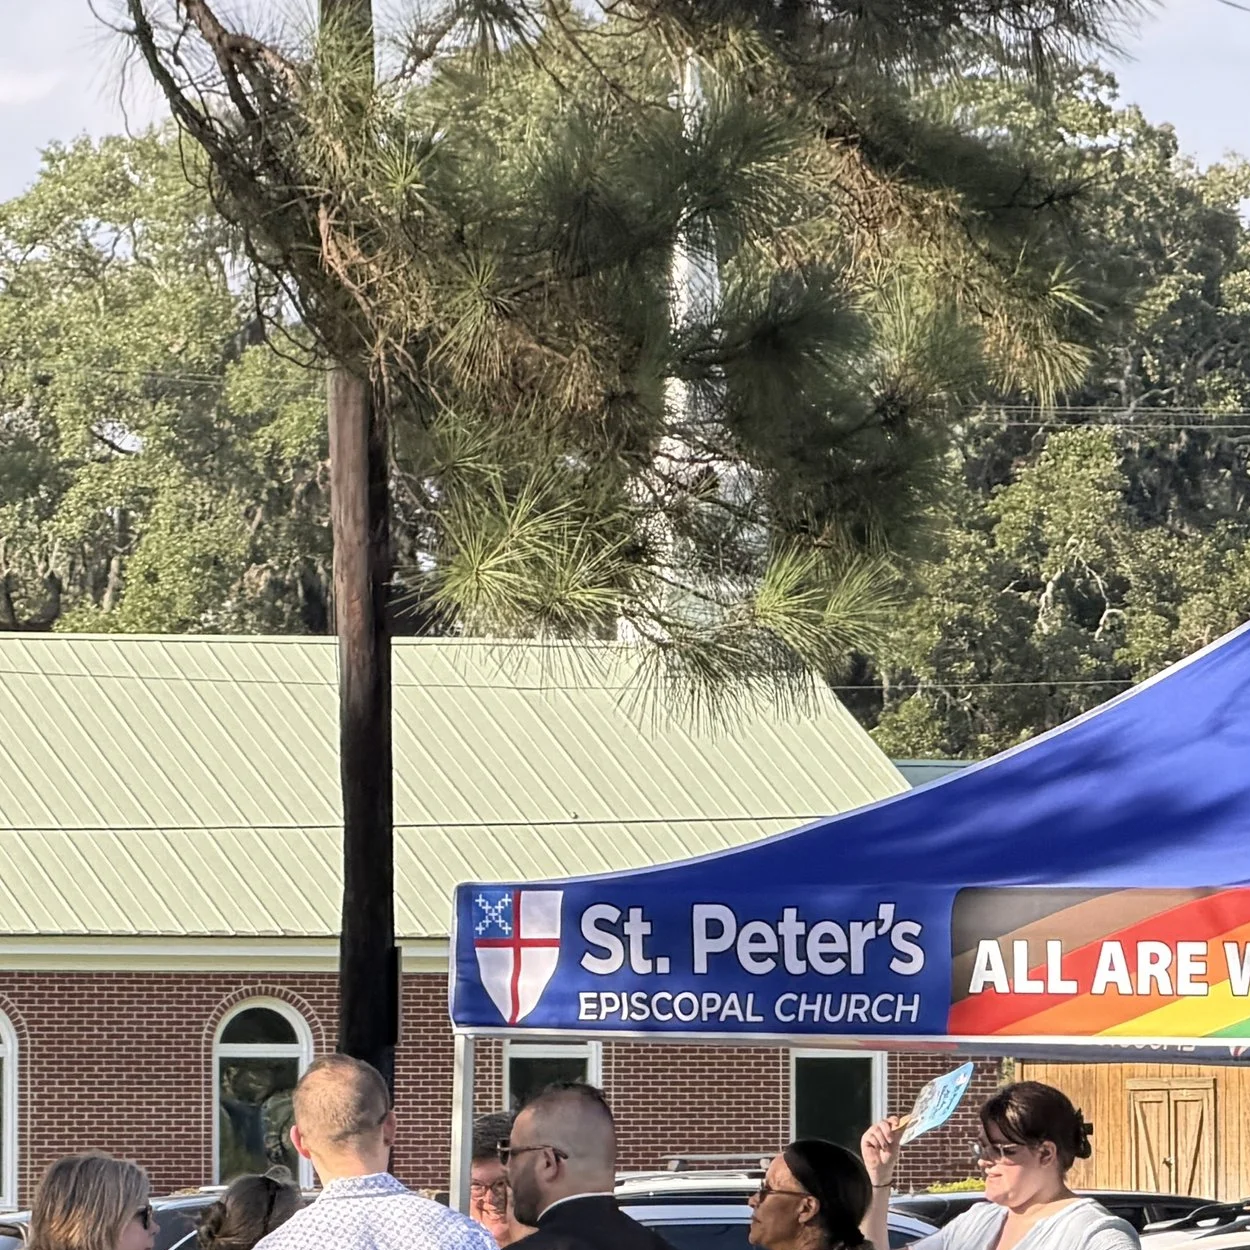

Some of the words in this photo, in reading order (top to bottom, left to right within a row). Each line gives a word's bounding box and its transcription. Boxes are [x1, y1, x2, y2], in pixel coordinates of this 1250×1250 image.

[580, 904, 669, 975] St.
[968, 940, 1078, 995] ALL
[1090, 942, 1208, 997] ARE
[578, 991, 763, 1023] EPISCOPAL
[775, 992, 921, 1025] CHURCH
